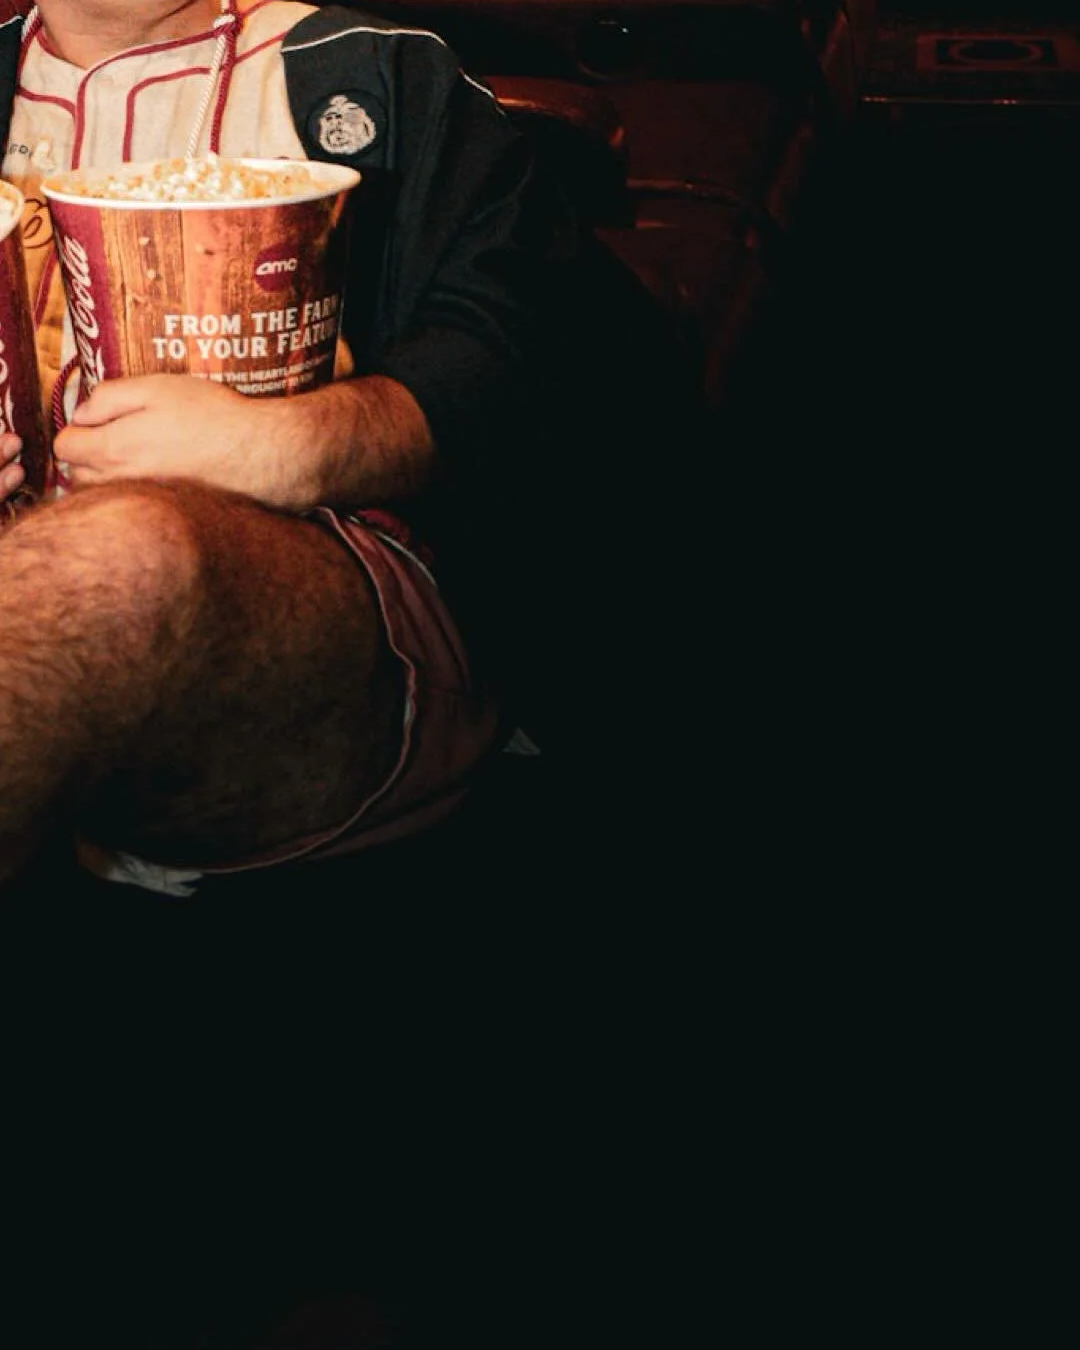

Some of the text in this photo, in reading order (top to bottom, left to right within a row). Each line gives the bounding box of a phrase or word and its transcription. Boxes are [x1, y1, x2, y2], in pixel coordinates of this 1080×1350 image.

[256, 257, 298, 276] amc
[163, 313, 241, 336] FROM
[251, 306, 299, 334] THE
[152, 336, 186, 360] TO
[196, 335, 268, 360] YOUR
